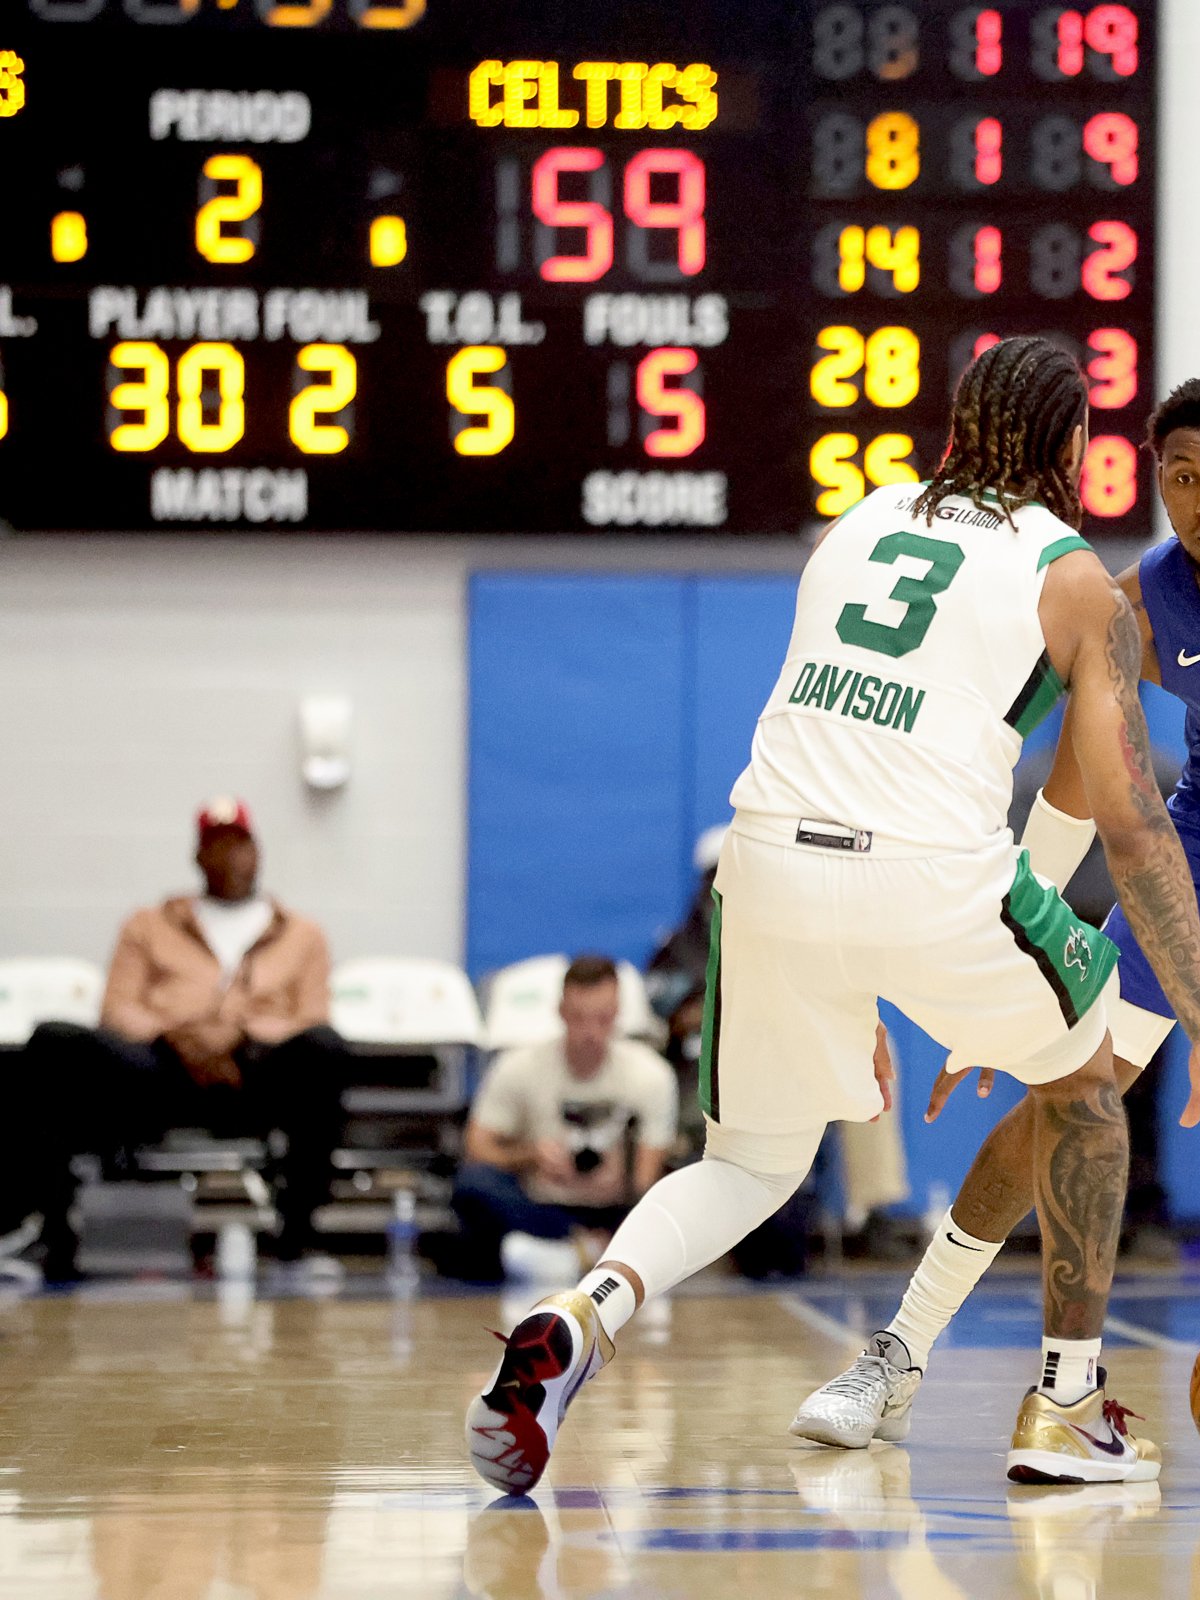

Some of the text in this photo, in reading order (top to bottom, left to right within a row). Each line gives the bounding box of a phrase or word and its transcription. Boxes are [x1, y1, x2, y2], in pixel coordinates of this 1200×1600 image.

[974, 3, 1138, 77] 1 19
[149, 88, 311, 143] PERIOD
[469, 60, 718, 131] CELTICS
[866, 111, 1138, 191] 8 1 9
[195, 154, 263, 263] 2
[532, 146, 706, 284] 59
[838, 220, 1137, 301] 14 1 2
[88, 285, 260, 342] PLAYER
[582, 293, 729, 349] FOULS
[109, 341, 245, 454] 30
[288, 343, 357, 455] 2
[445, 345, 516, 456] 5
[636, 347, 705, 458] 5
[809, 325, 1137, 410] 28 3
[150, 466, 308, 522] MATCH
[581, 470, 728, 527] SCORE
[809, 431, 919, 516] 55
[835, 531, 966, 659] 3
[788, 662, 926, 734] DAVISON
